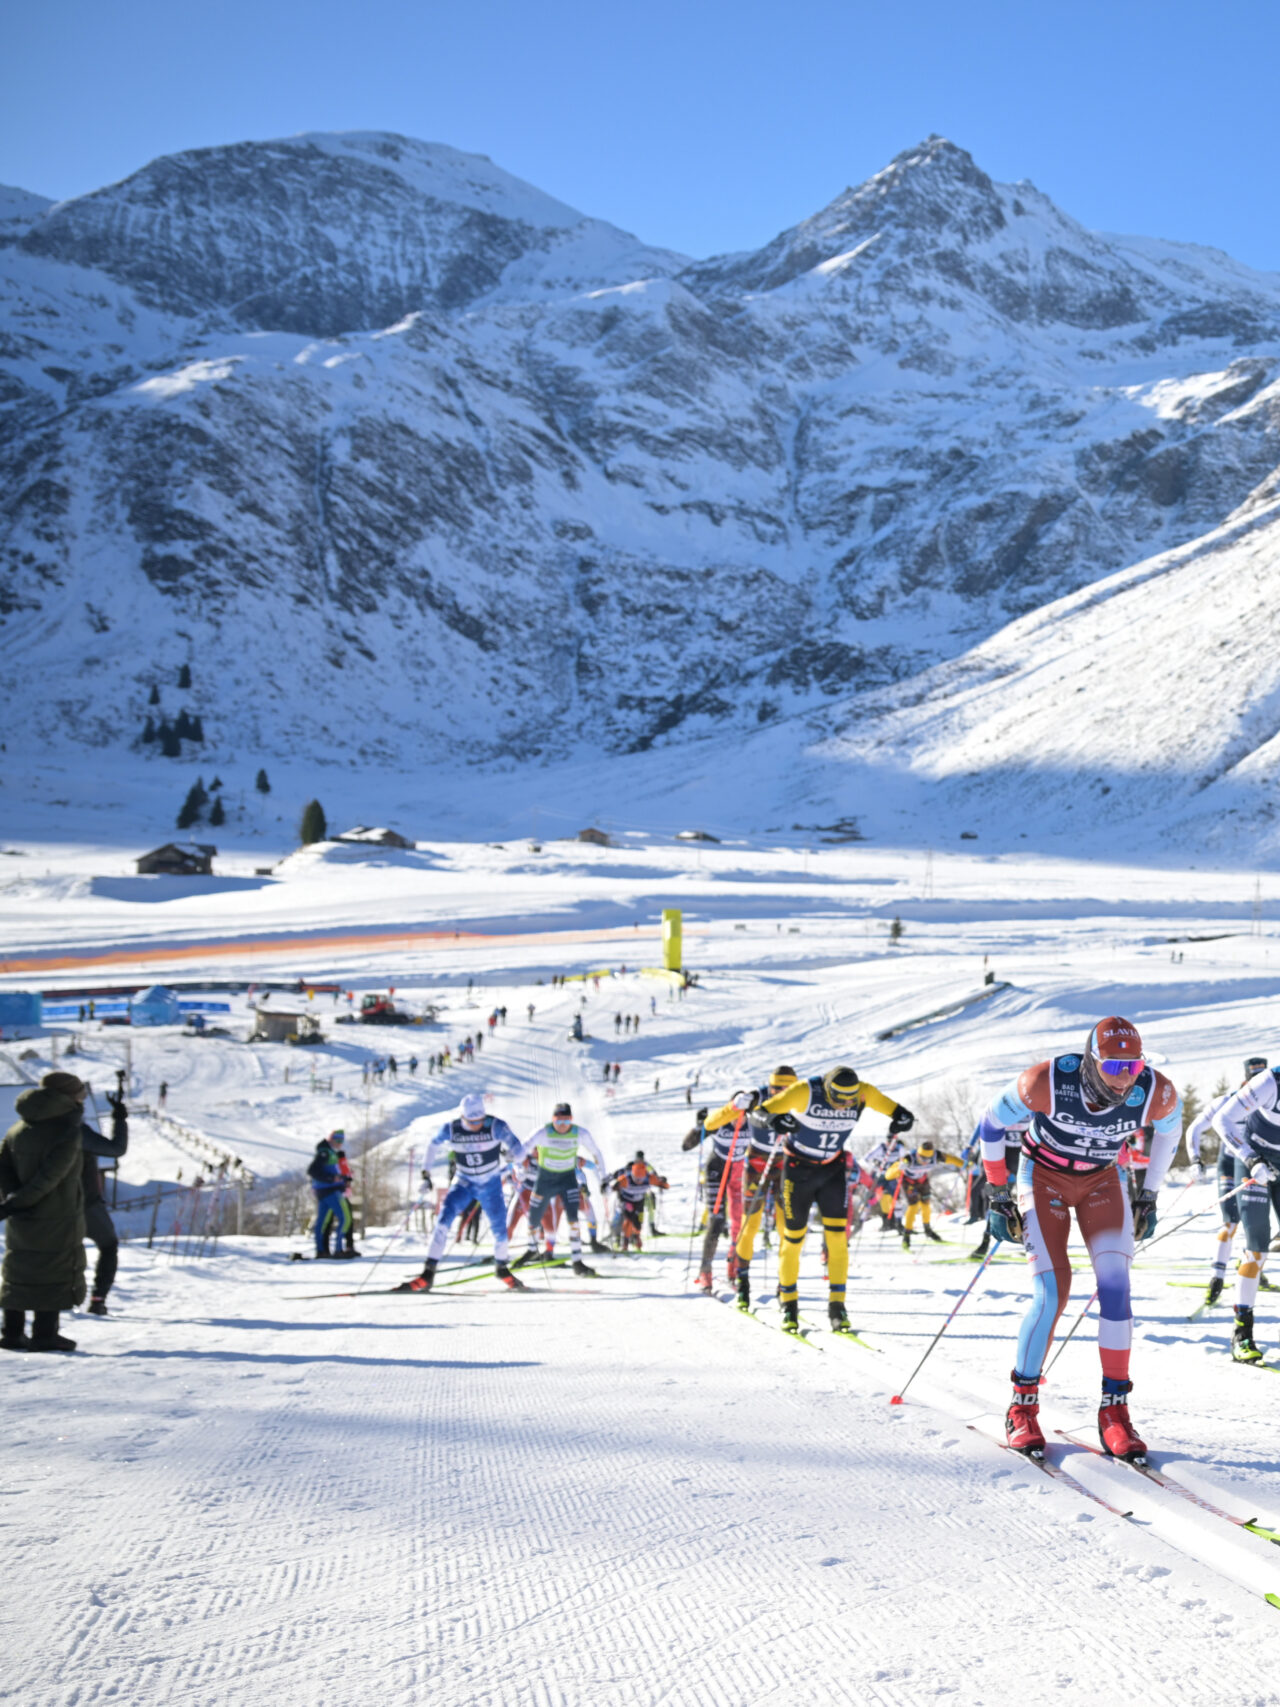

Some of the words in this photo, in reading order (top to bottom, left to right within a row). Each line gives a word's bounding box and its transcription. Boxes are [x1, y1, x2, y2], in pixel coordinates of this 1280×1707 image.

[810, 1104, 857, 1119] Gastein
[818, 1133, 840, 1149] 12
[465, 1154, 483, 1166] 83
